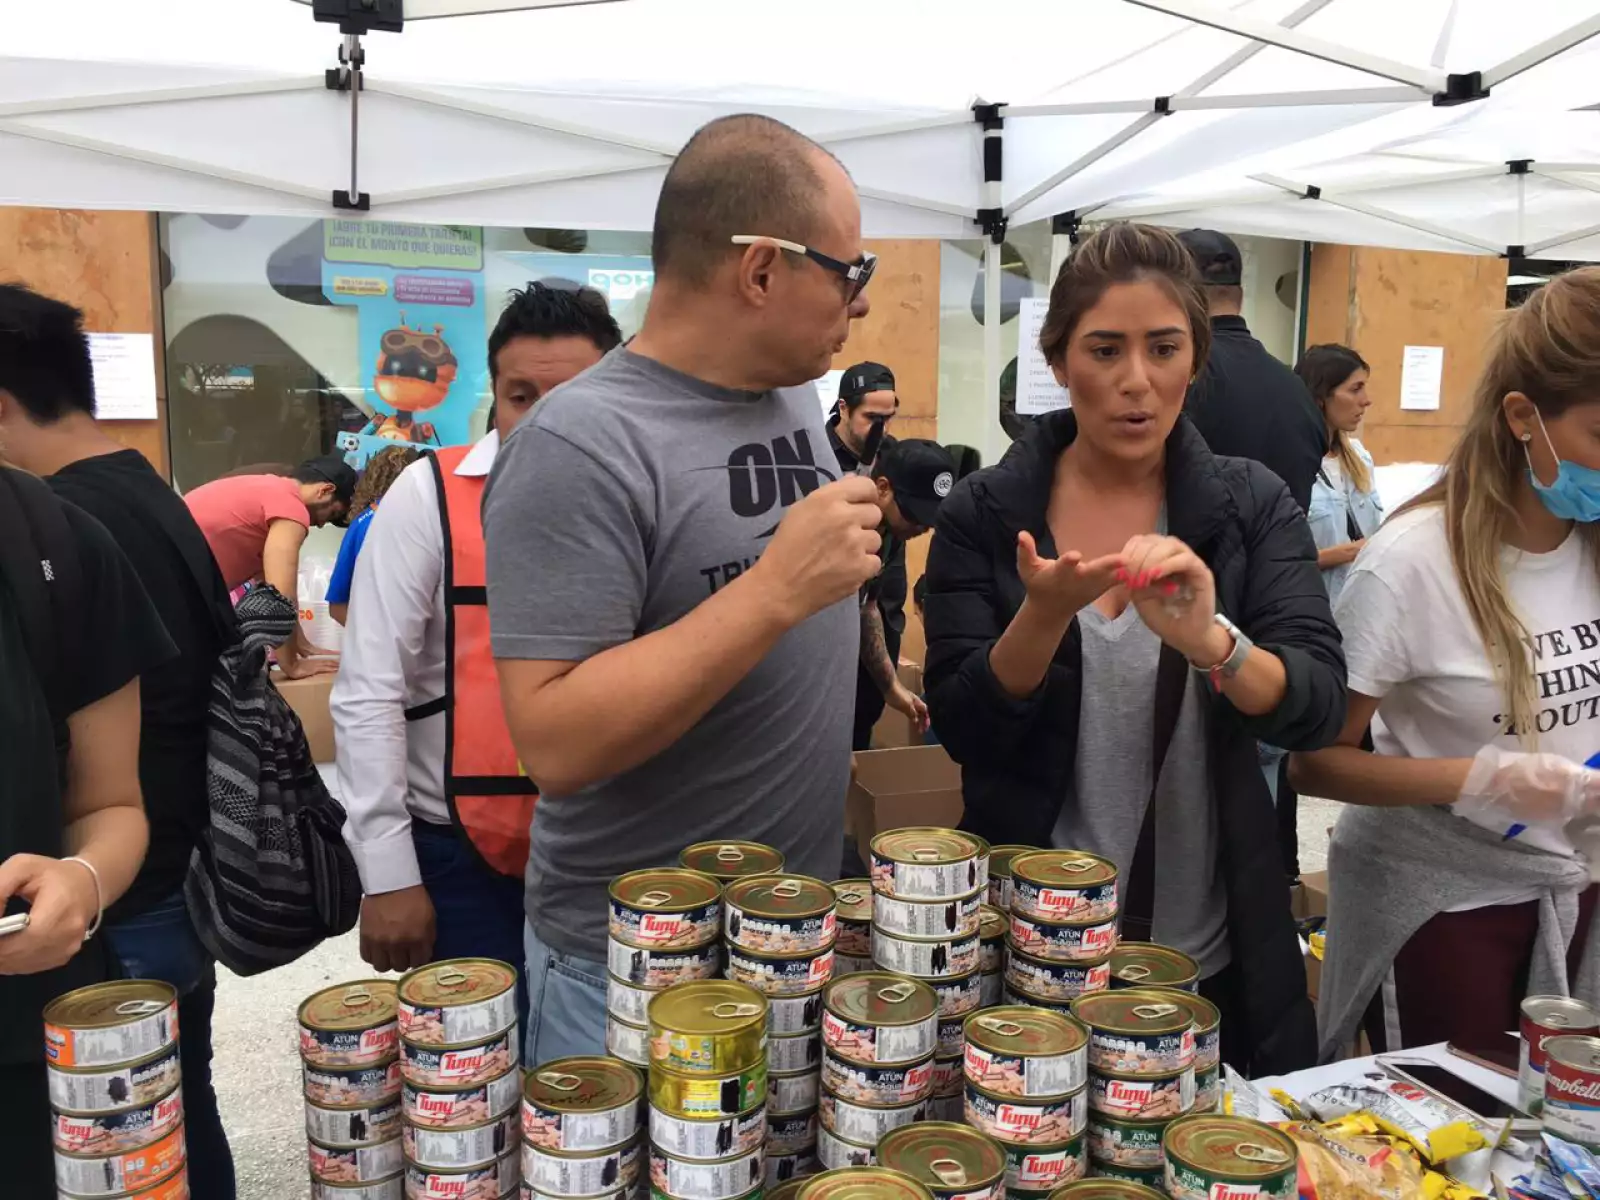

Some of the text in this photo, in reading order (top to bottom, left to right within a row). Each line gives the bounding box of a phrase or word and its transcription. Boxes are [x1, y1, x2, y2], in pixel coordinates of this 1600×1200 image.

[728, 429, 820, 518] ON
[1042, 889, 1077, 911] Tuny
[644, 915, 681, 937] Tuny
[444, 1053, 484, 1072] Tuny
[1110, 1081, 1152, 1105] Tuny
[419, 1094, 456, 1116] Tuny
[60, 1116, 94, 1141] Tuny
[1000, 1105, 1043, 1130] Tuny
[1026, 1156, 1066, 1177] Tuny
[429, 1175, 468, 1199] Tuny
